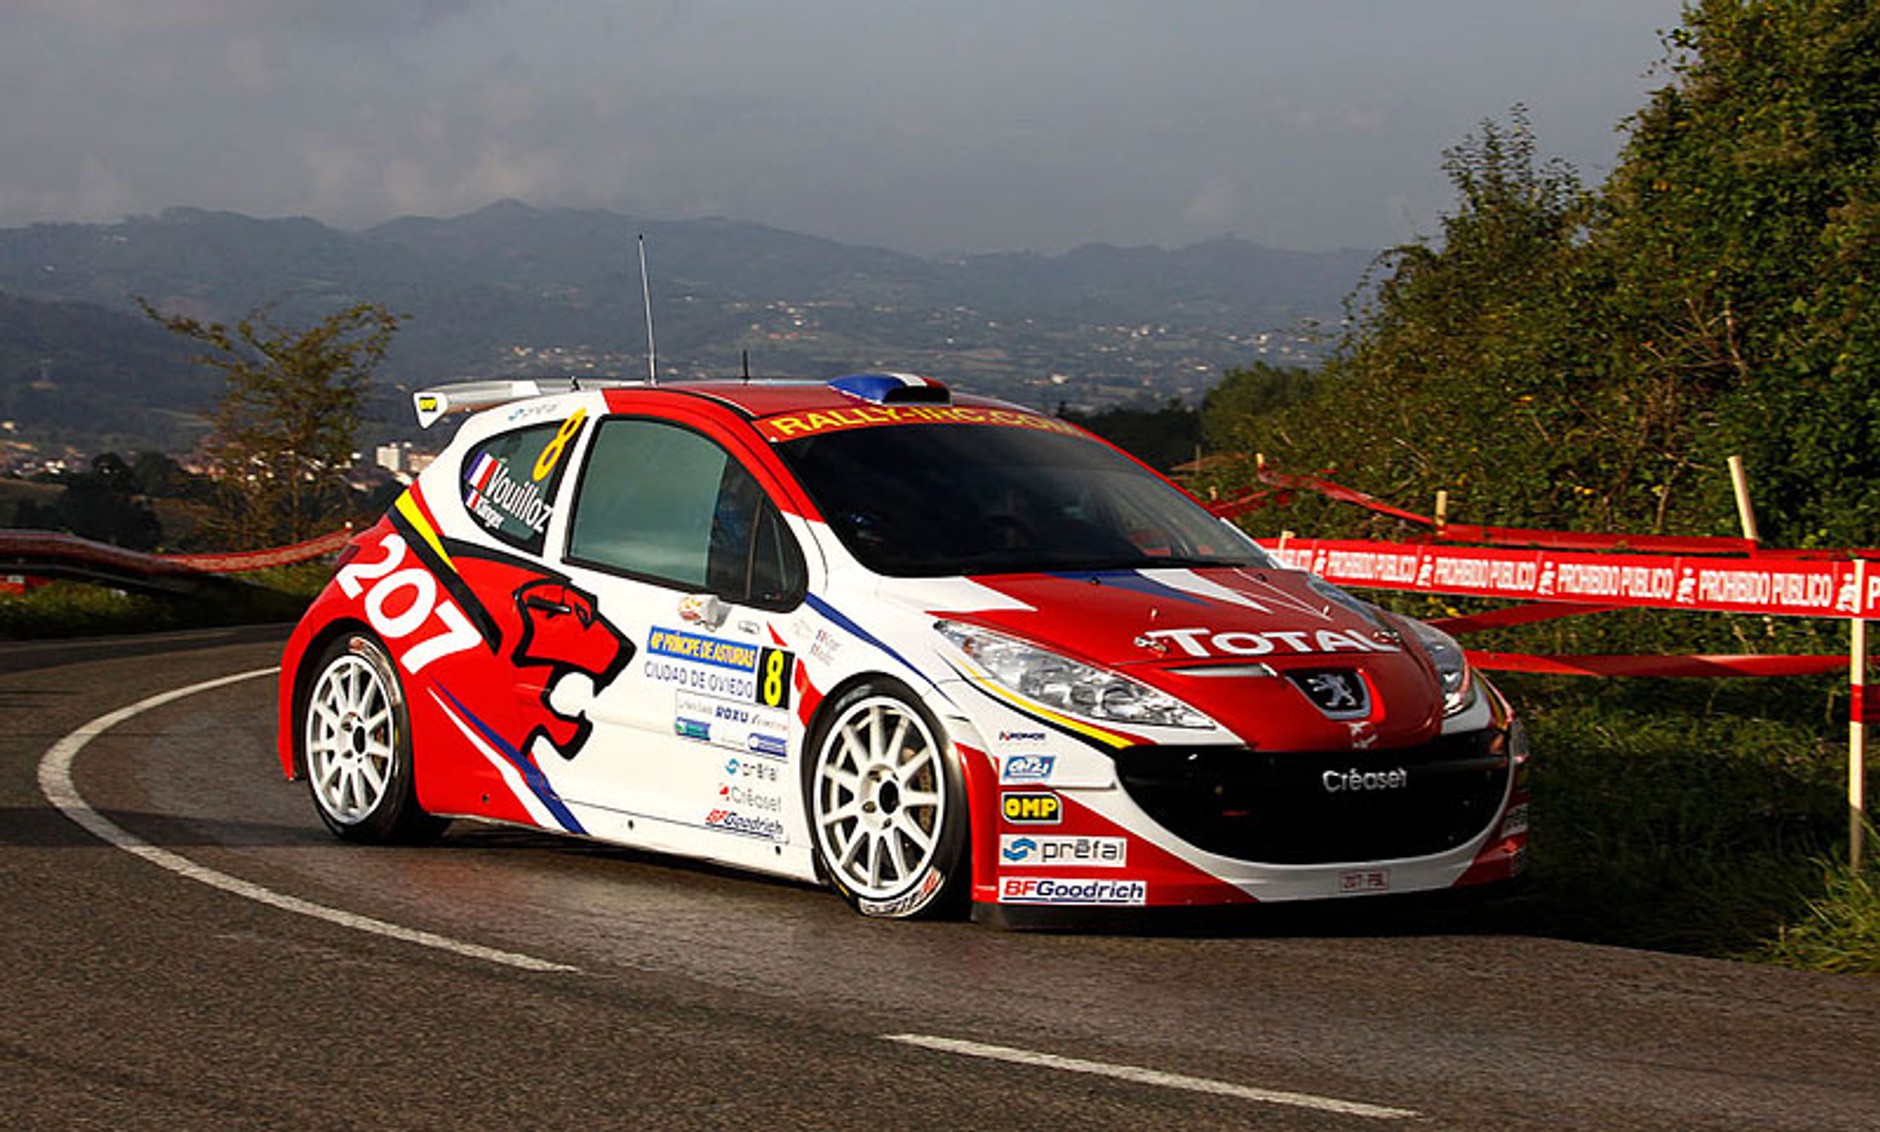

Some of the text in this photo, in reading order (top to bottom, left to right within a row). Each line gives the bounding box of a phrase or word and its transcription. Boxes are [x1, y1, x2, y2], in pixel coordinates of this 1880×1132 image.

[531, 406, 586, 482] 8
[485, 462, 553, 534] Vouilloz
[335, 532, 484, 676] 207
[1699, 569, 1771, 604] PROHIBIDO
[1144, 628, 1400, 657] TOTAL
[644, 660, 753, 699] CIUDAD DE OVIEDO
[764, 649, 784, 707] 8
[705, 808, 784, 835] BFGoodrich
[1004, 798, 1058, 818] OMP
[1003, 880, 1144, 899] BFGoodrich
